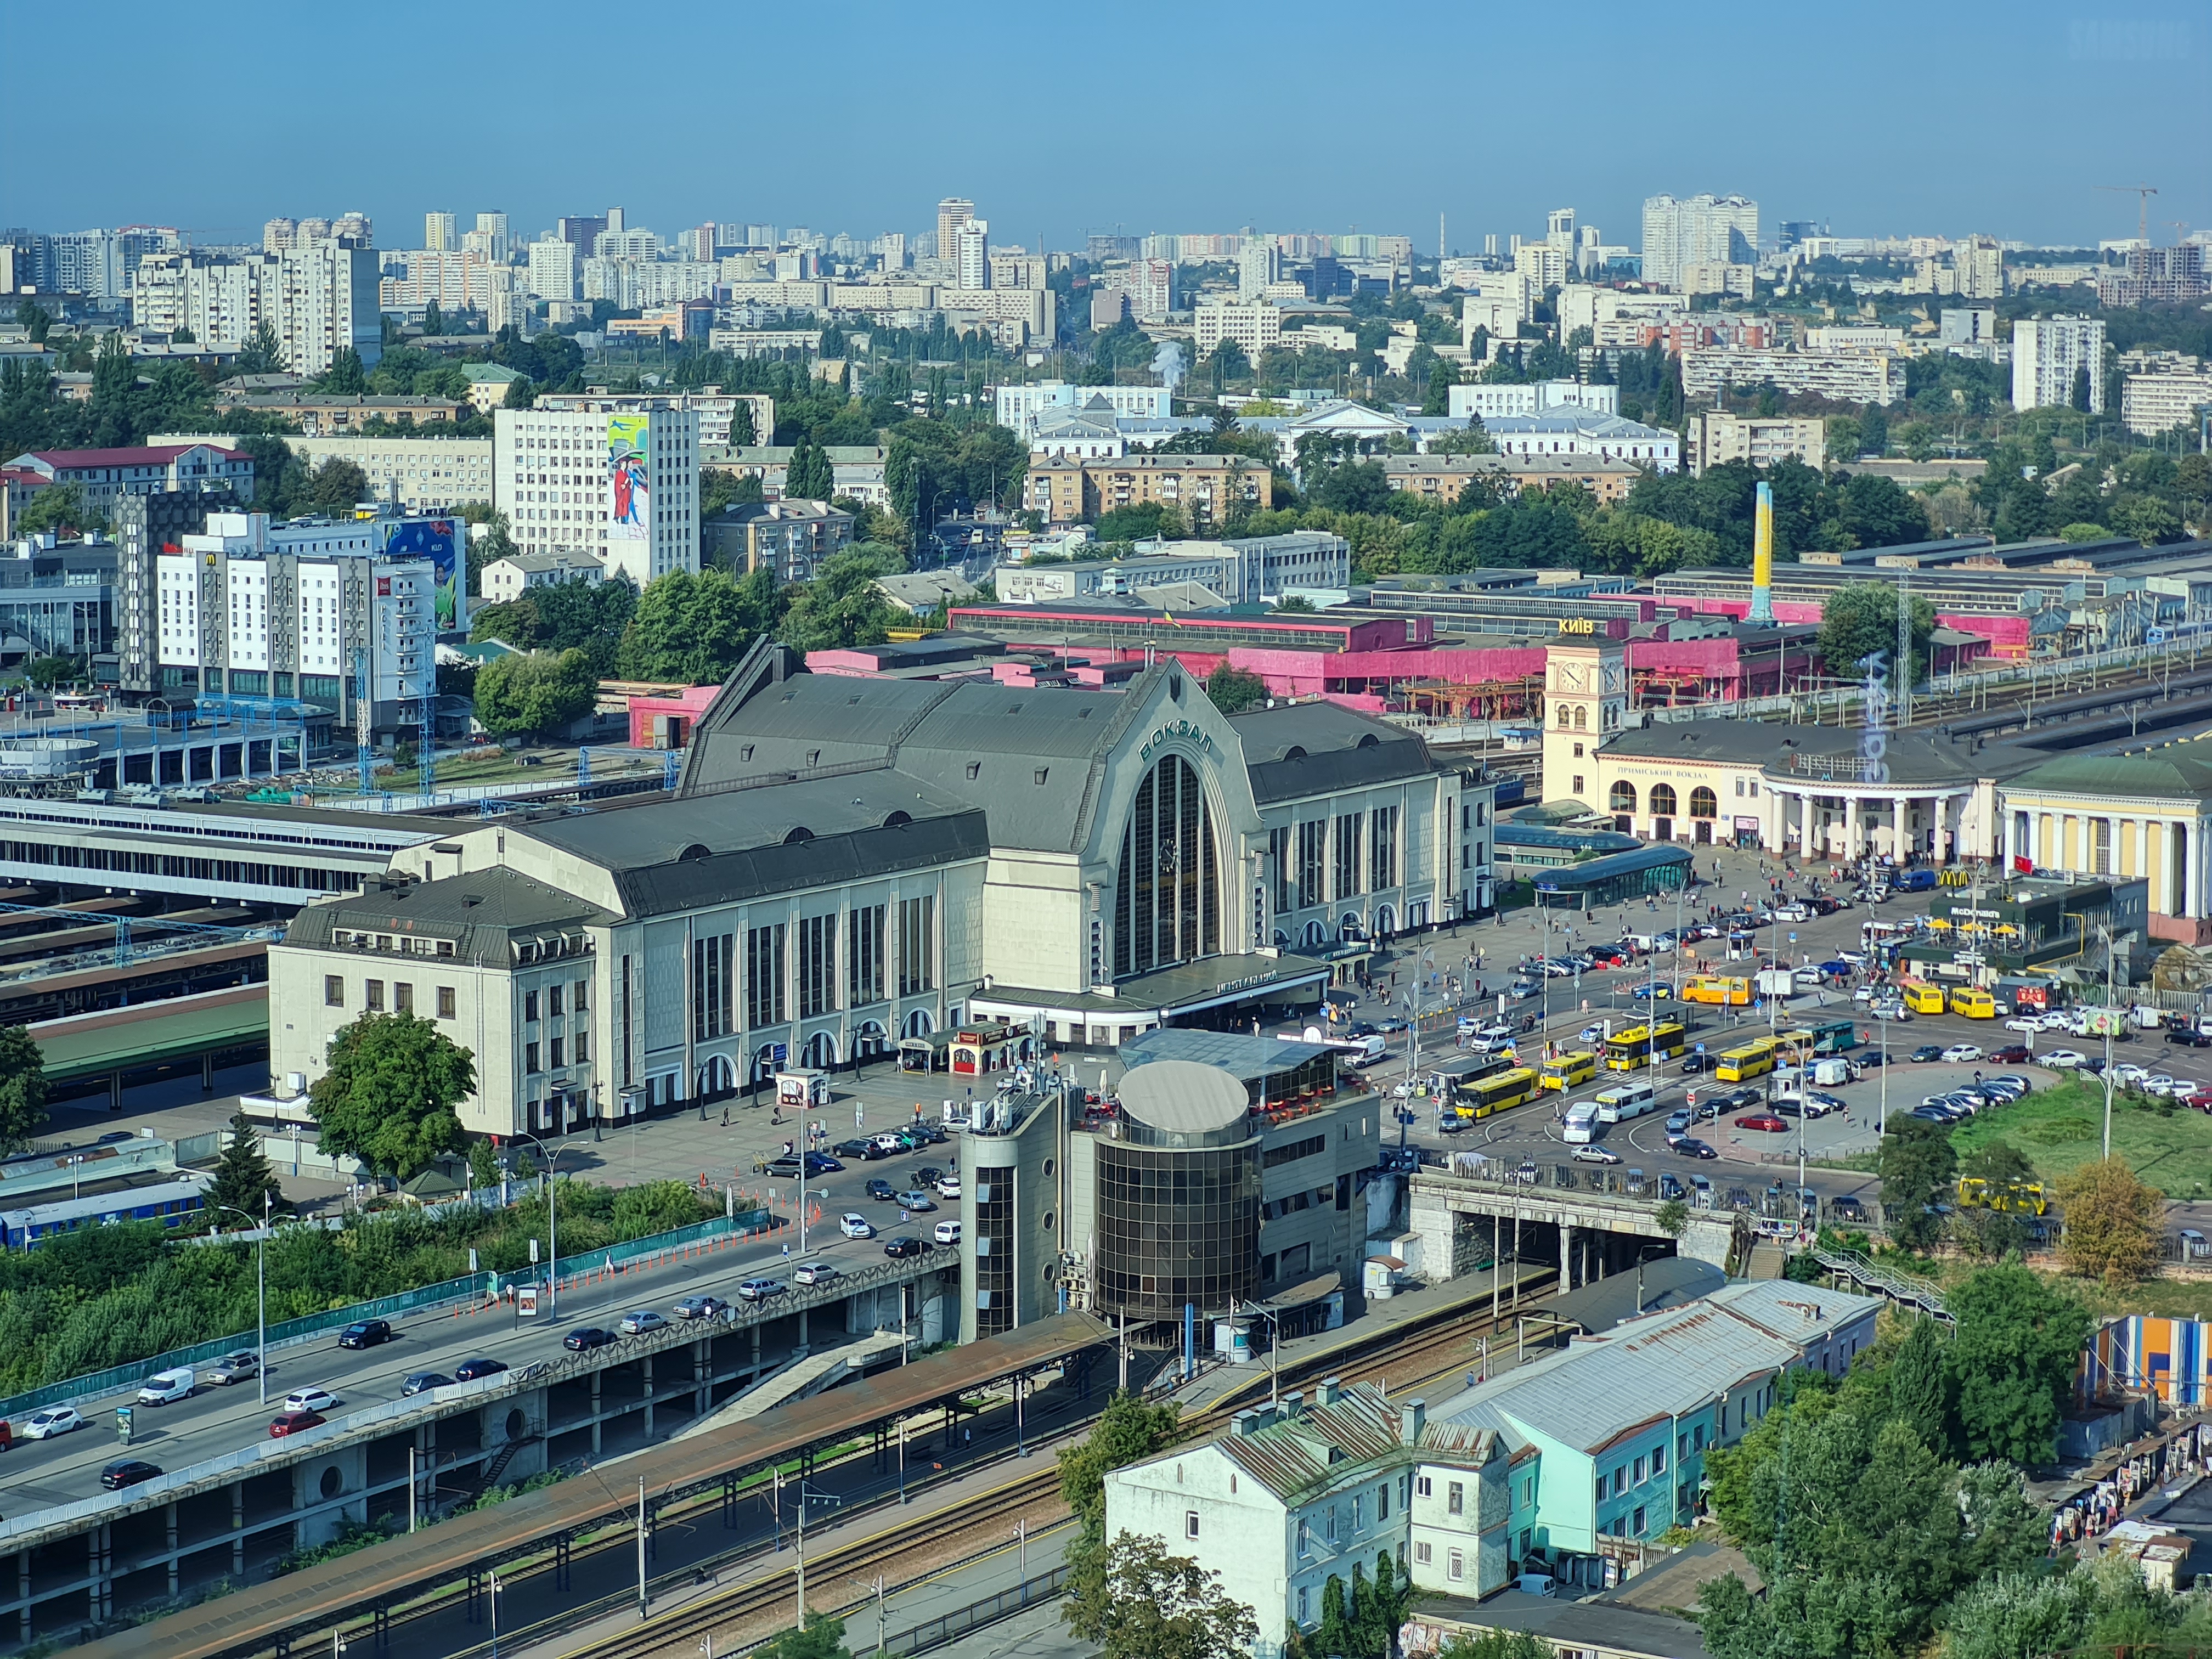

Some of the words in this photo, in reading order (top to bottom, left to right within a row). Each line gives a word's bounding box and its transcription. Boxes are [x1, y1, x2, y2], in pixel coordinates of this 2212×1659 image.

[1559, 617, 1594, 634] КИЇВ
[1138, 719, 1212, 763] ВОКЗАЛ
[1618, 767, 1672, 777] ПРИМІСЬКИЙ
[1677, 771, 1708, 780] ВОКЗАЛ
